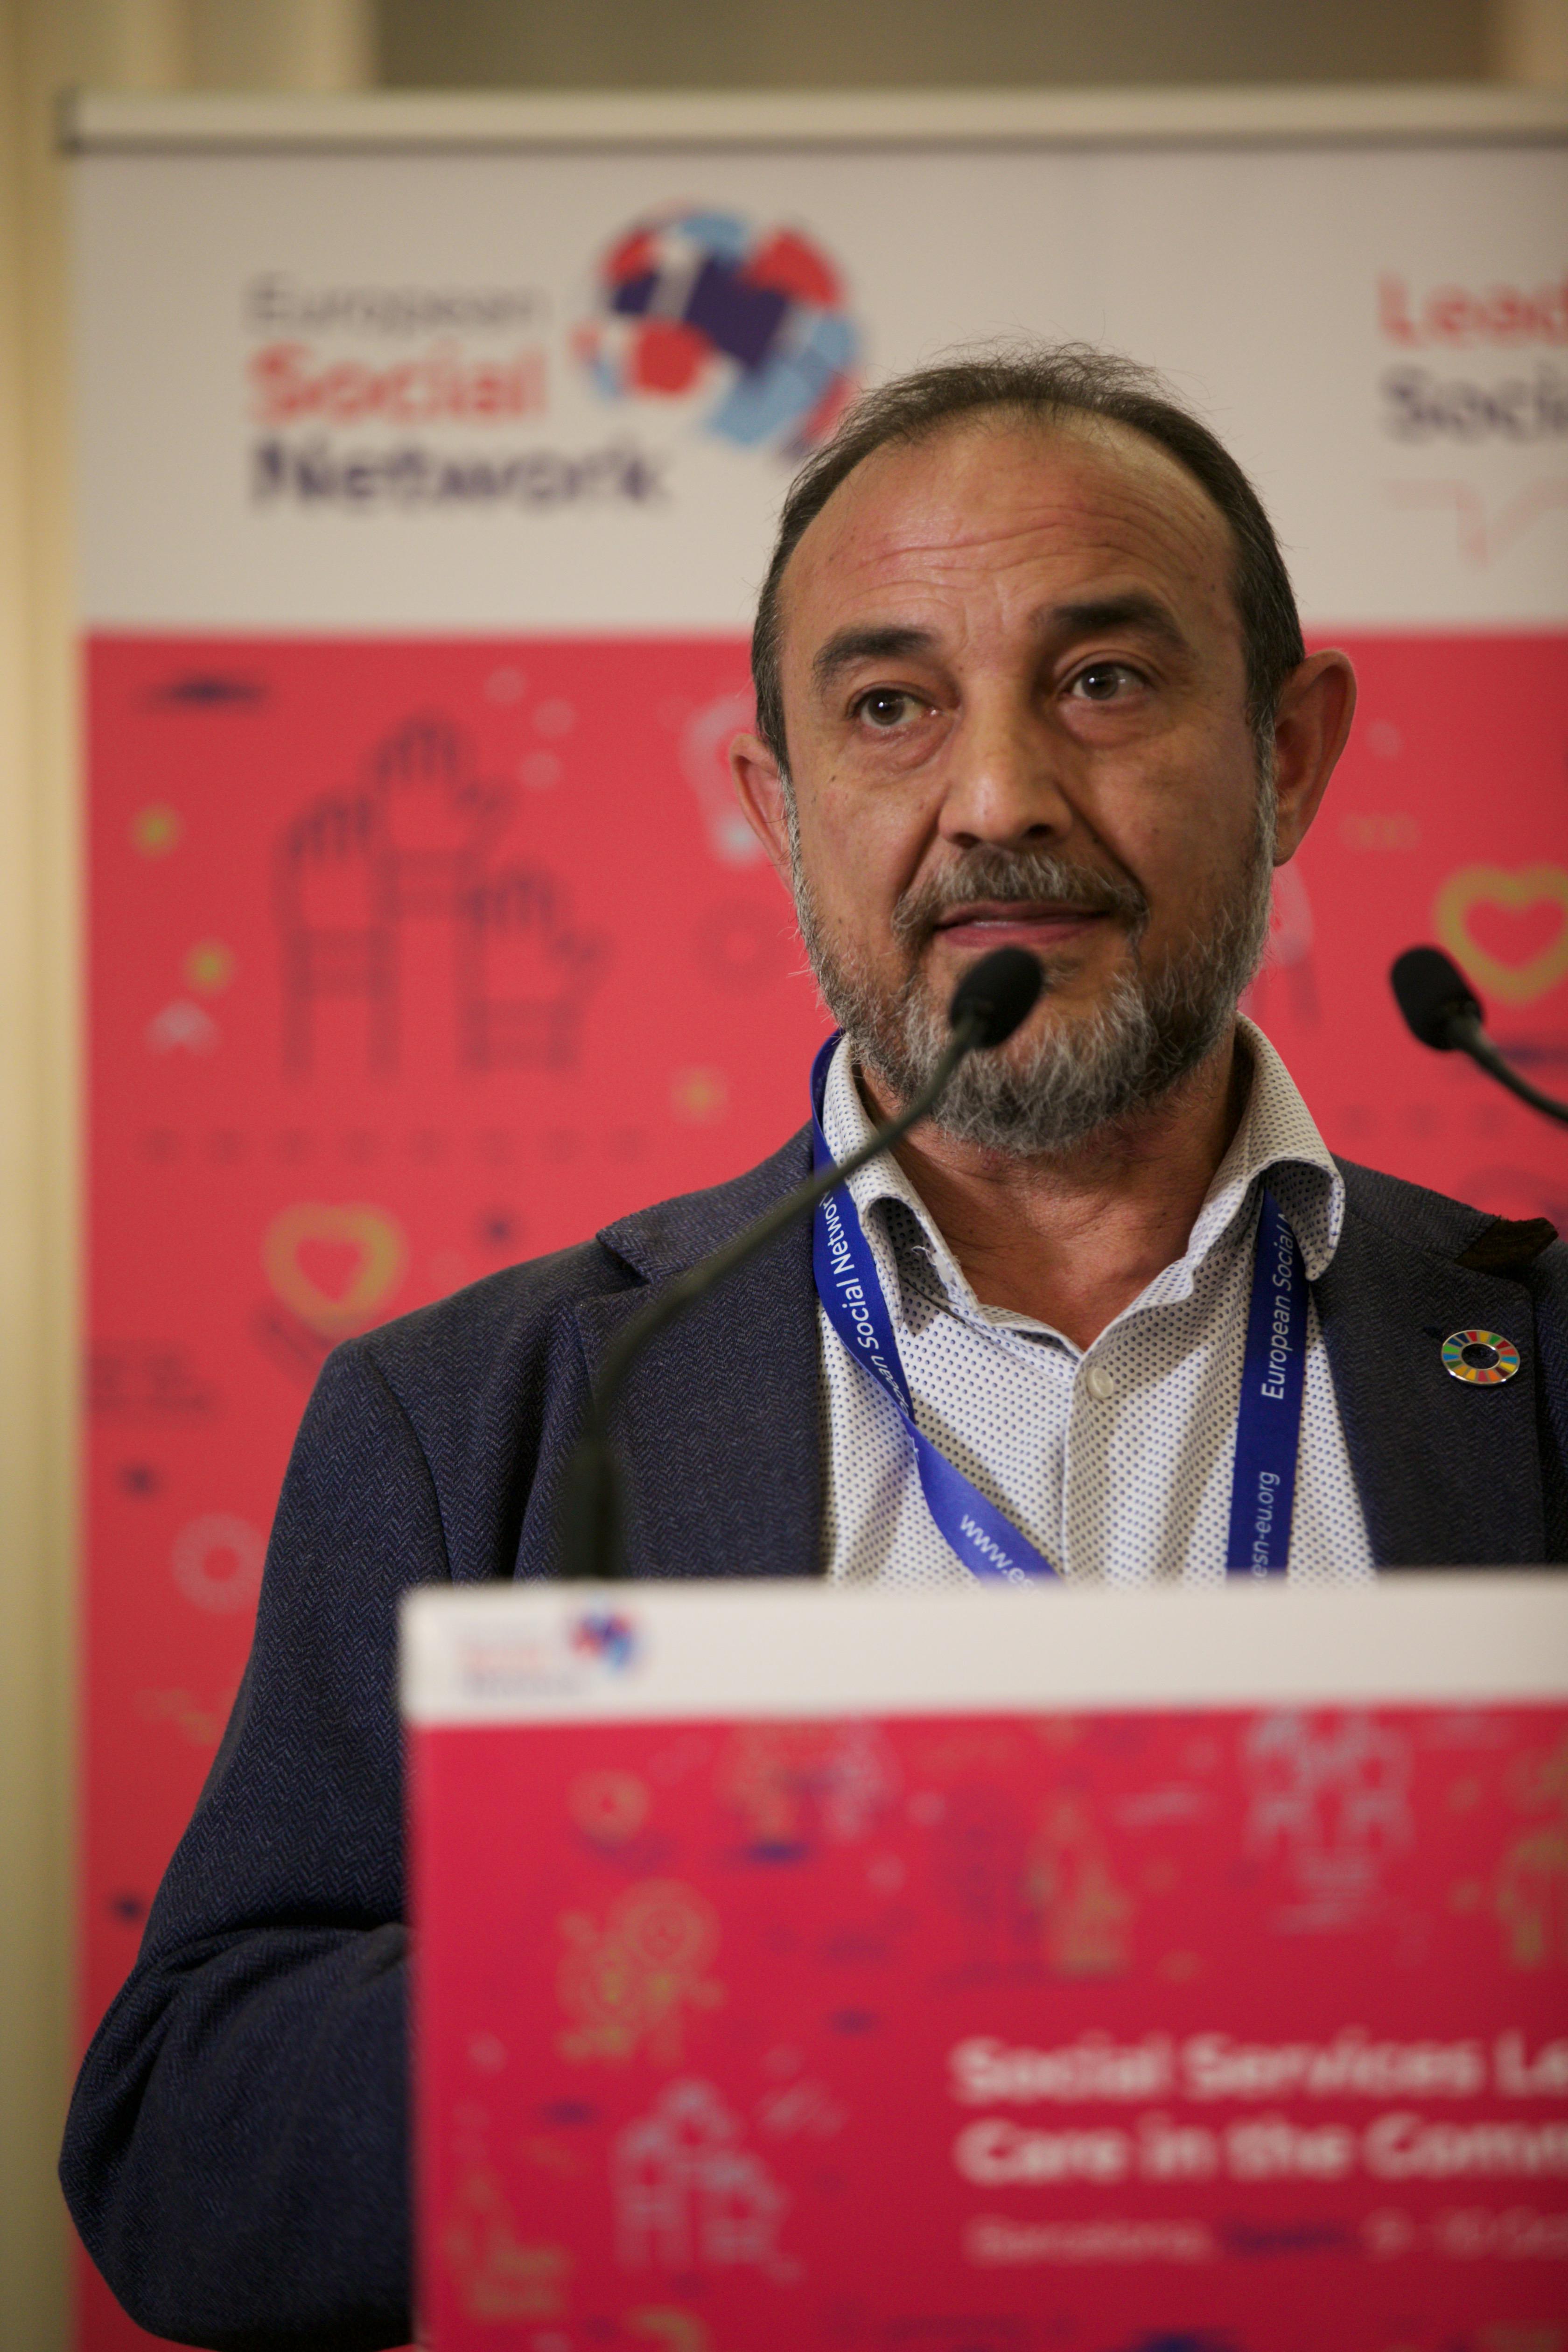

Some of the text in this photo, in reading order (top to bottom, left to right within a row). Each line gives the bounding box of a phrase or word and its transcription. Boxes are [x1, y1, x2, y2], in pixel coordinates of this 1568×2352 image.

[250, 274, 544, 340] European
[252, 343, 544, 424] Social
[252, 434, 665, 510] Network
[1273, 1224, 1294, 1292] Social
[836, 1278, 879, 1350] Social
[1261, 1295, 1293, 1400] European
[952, 2035, 1171, 2101] Social
[1184, 2030, 1483, 2097] Services
[958, 2121, 1128, 2183] Care
[1141, 2114, 1212, 2179] in
[1225, 2117, 1351, 2178] the
